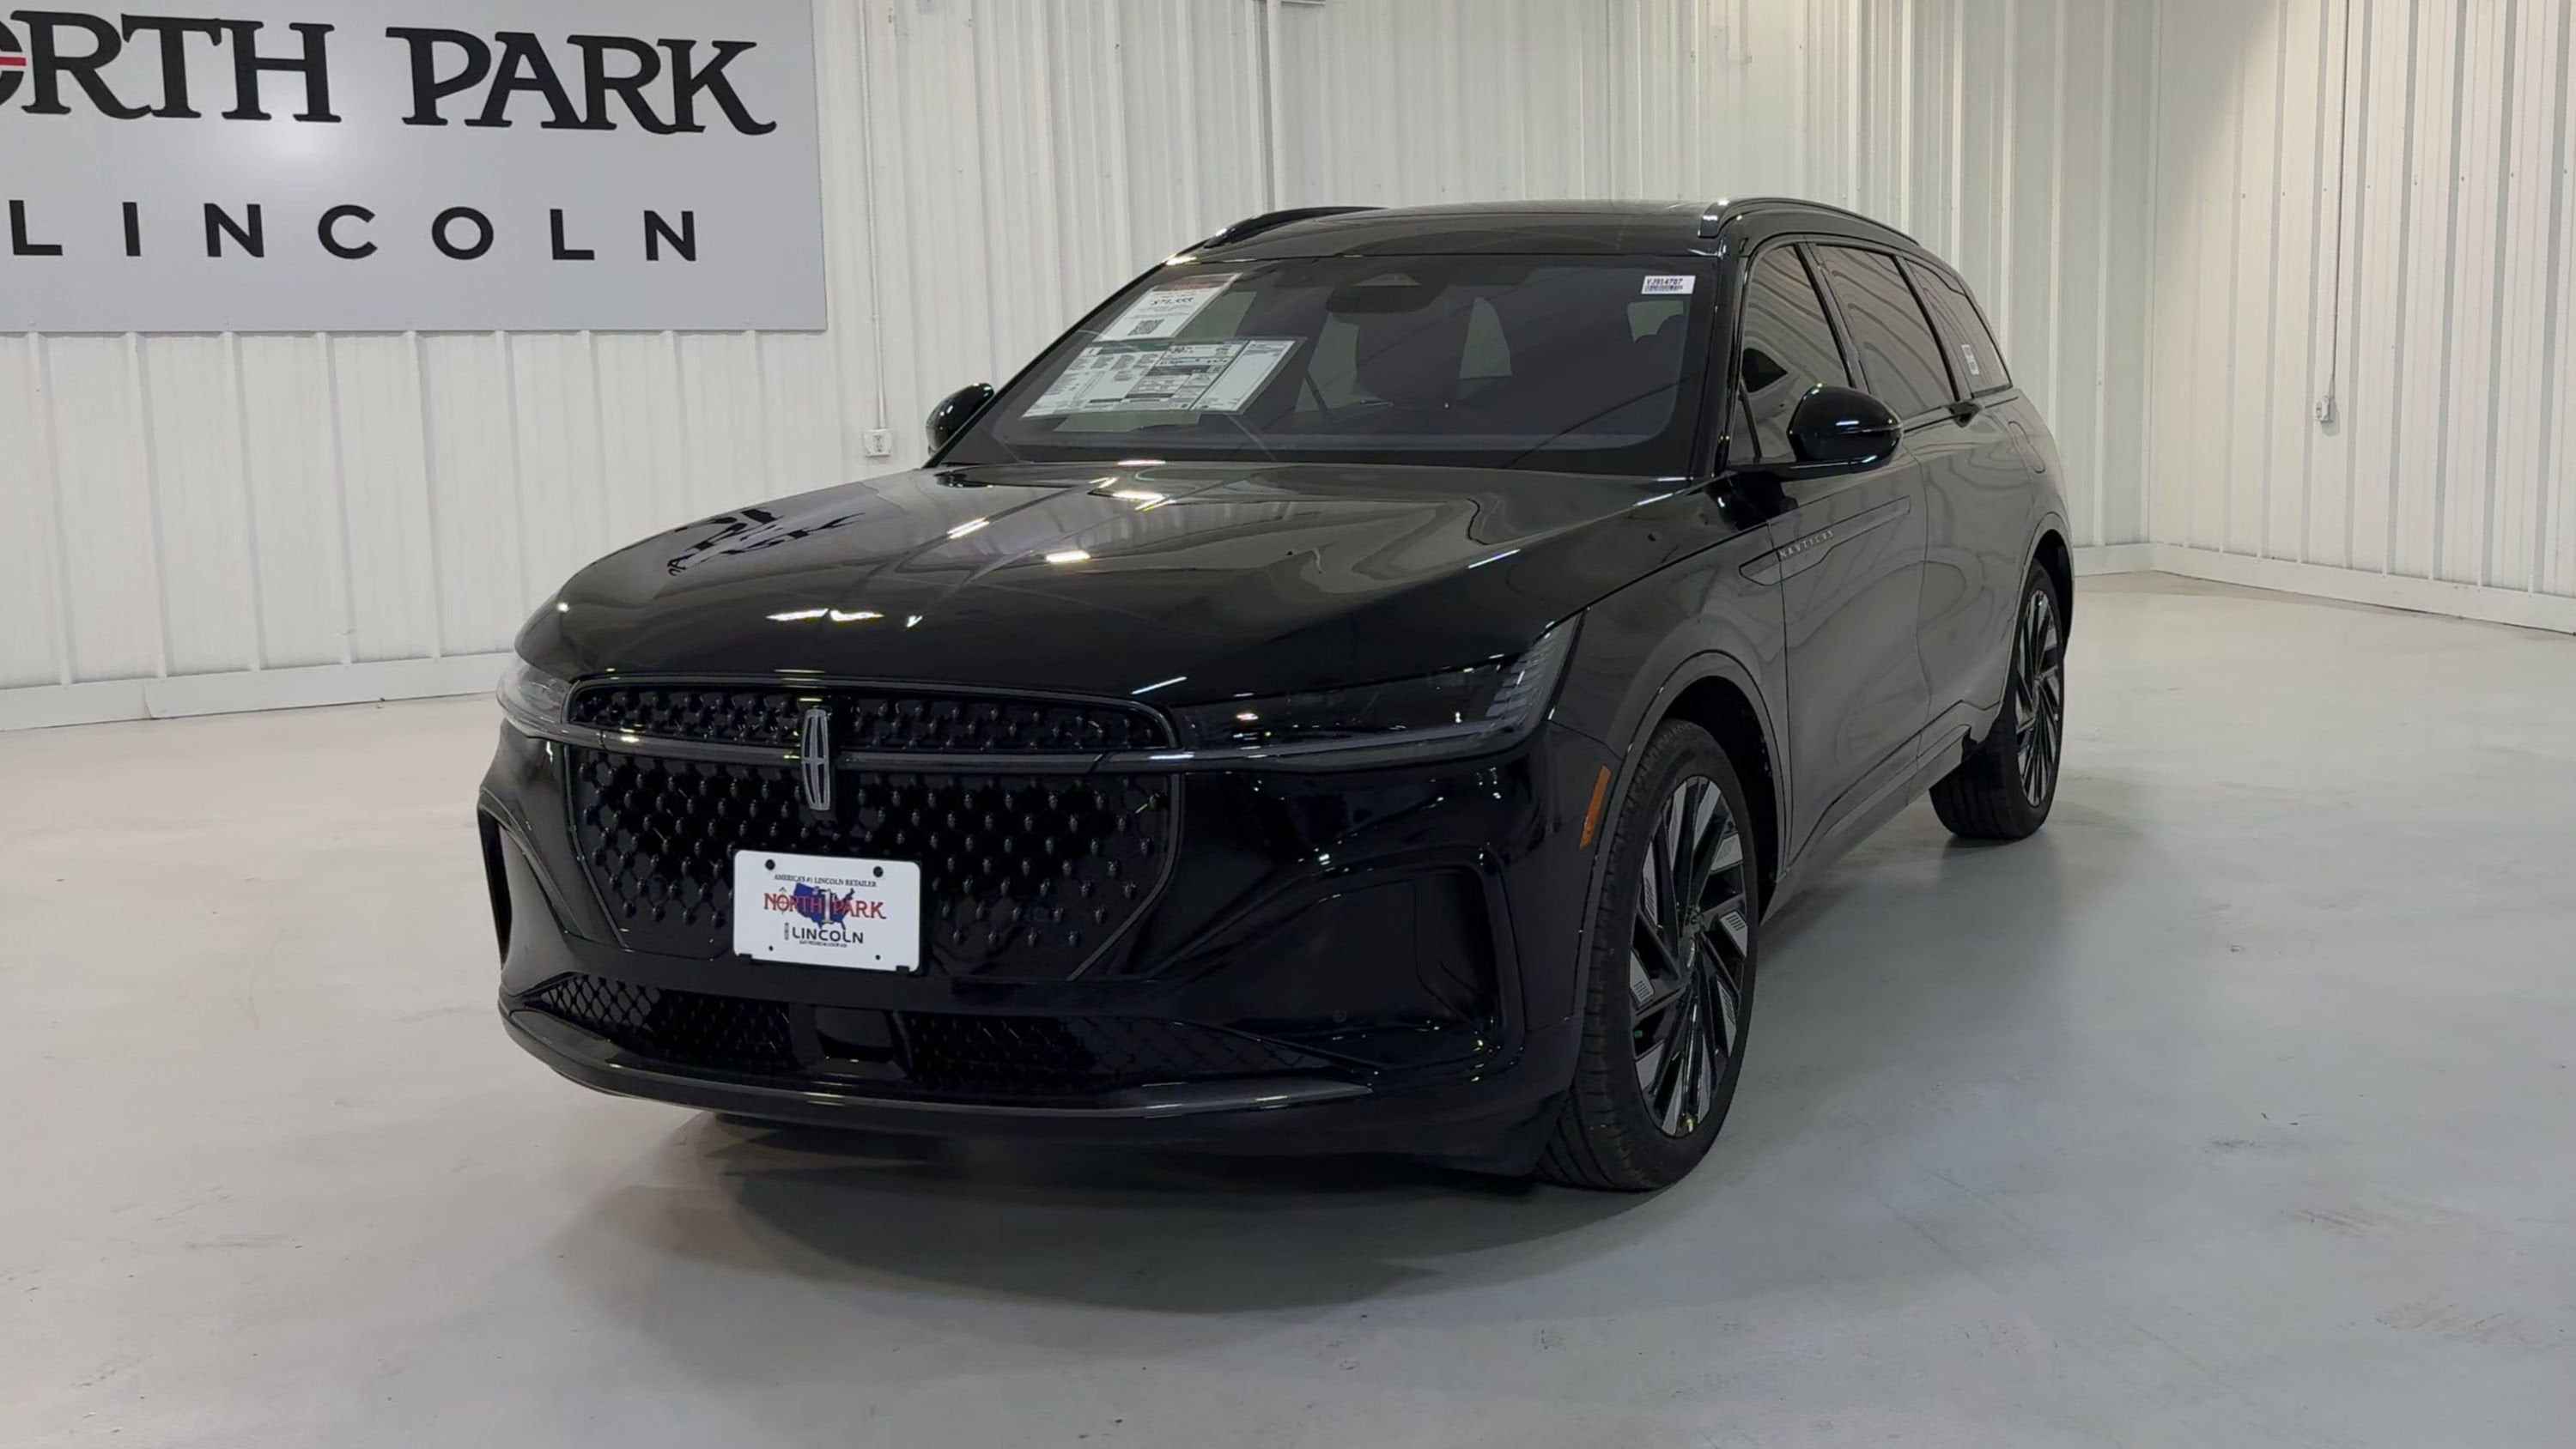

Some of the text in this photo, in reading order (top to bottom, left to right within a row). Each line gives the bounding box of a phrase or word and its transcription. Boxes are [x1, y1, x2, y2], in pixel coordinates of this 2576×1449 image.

[0, 9, 777, 136] RTH PARK
[9, 199, 697, 263] LINCOLN
[774, 874, 805, 883] AMERICA'S
[814, 876, 844, 886] LINCOLN
[845, 878, 878, 888] RETAILER
[764, 893, 887, 919] NORTH PARK
[792, 927, 864, 943] LINCOLN
